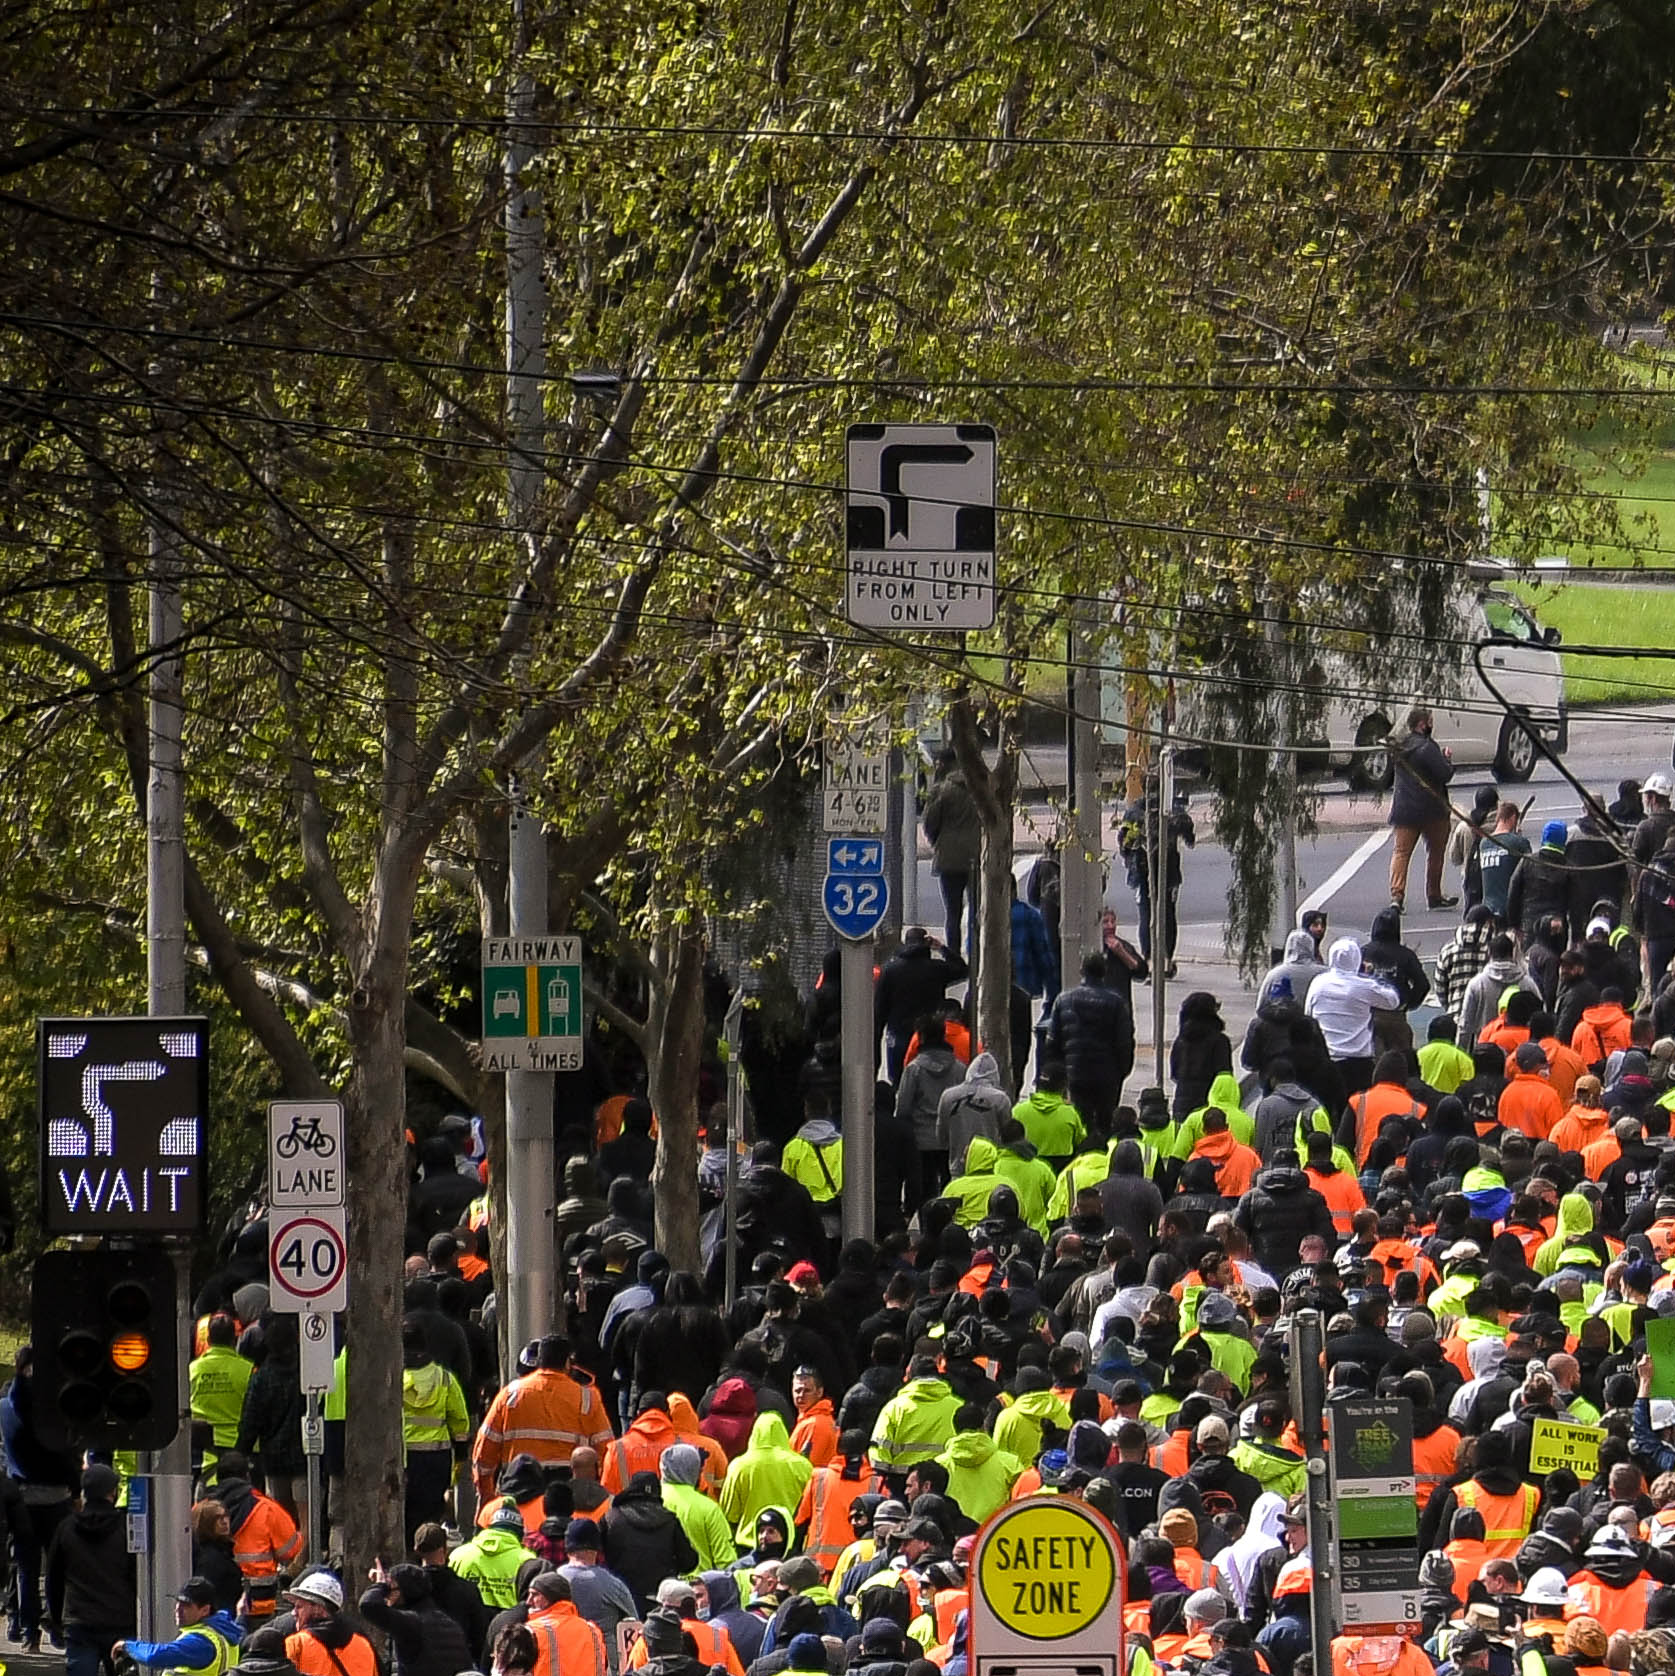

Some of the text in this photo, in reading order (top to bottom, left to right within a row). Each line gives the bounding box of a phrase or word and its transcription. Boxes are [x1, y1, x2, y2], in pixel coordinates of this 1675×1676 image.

[852, 559, 989, 579] RIGHT TURN
[855, 581, 985, 601] FROM LEFT
[890, 604, 950, 622] ONLY
[829, 764, 882, 786] LANE
[832, 883, 878, 916] 32
[489, 941, 574, 961] FAIRWAY
[487, 1053, 579, 1071] ALL TIMES
[58, 1167, 190, 1213] WAIT
[277, 1169, 337, 1193] LANE
[279, 1239, 337, 1278] 40
[1540, 1427, 1600, 1445] ALL WORK
[1563, 1444, 1575, 1456] IS
[1536, 1455, 1598, 1473] ESSENTIAL
[996, 1536, 1097, 1571] SAFETY
[1343, 1555, 1361, 1569] 30
[1343, 1576, 1361, 1590] 35
[1012, 1581, 1082, 1616] ZONE
[1404, 1602, 1418, 1620] 8
